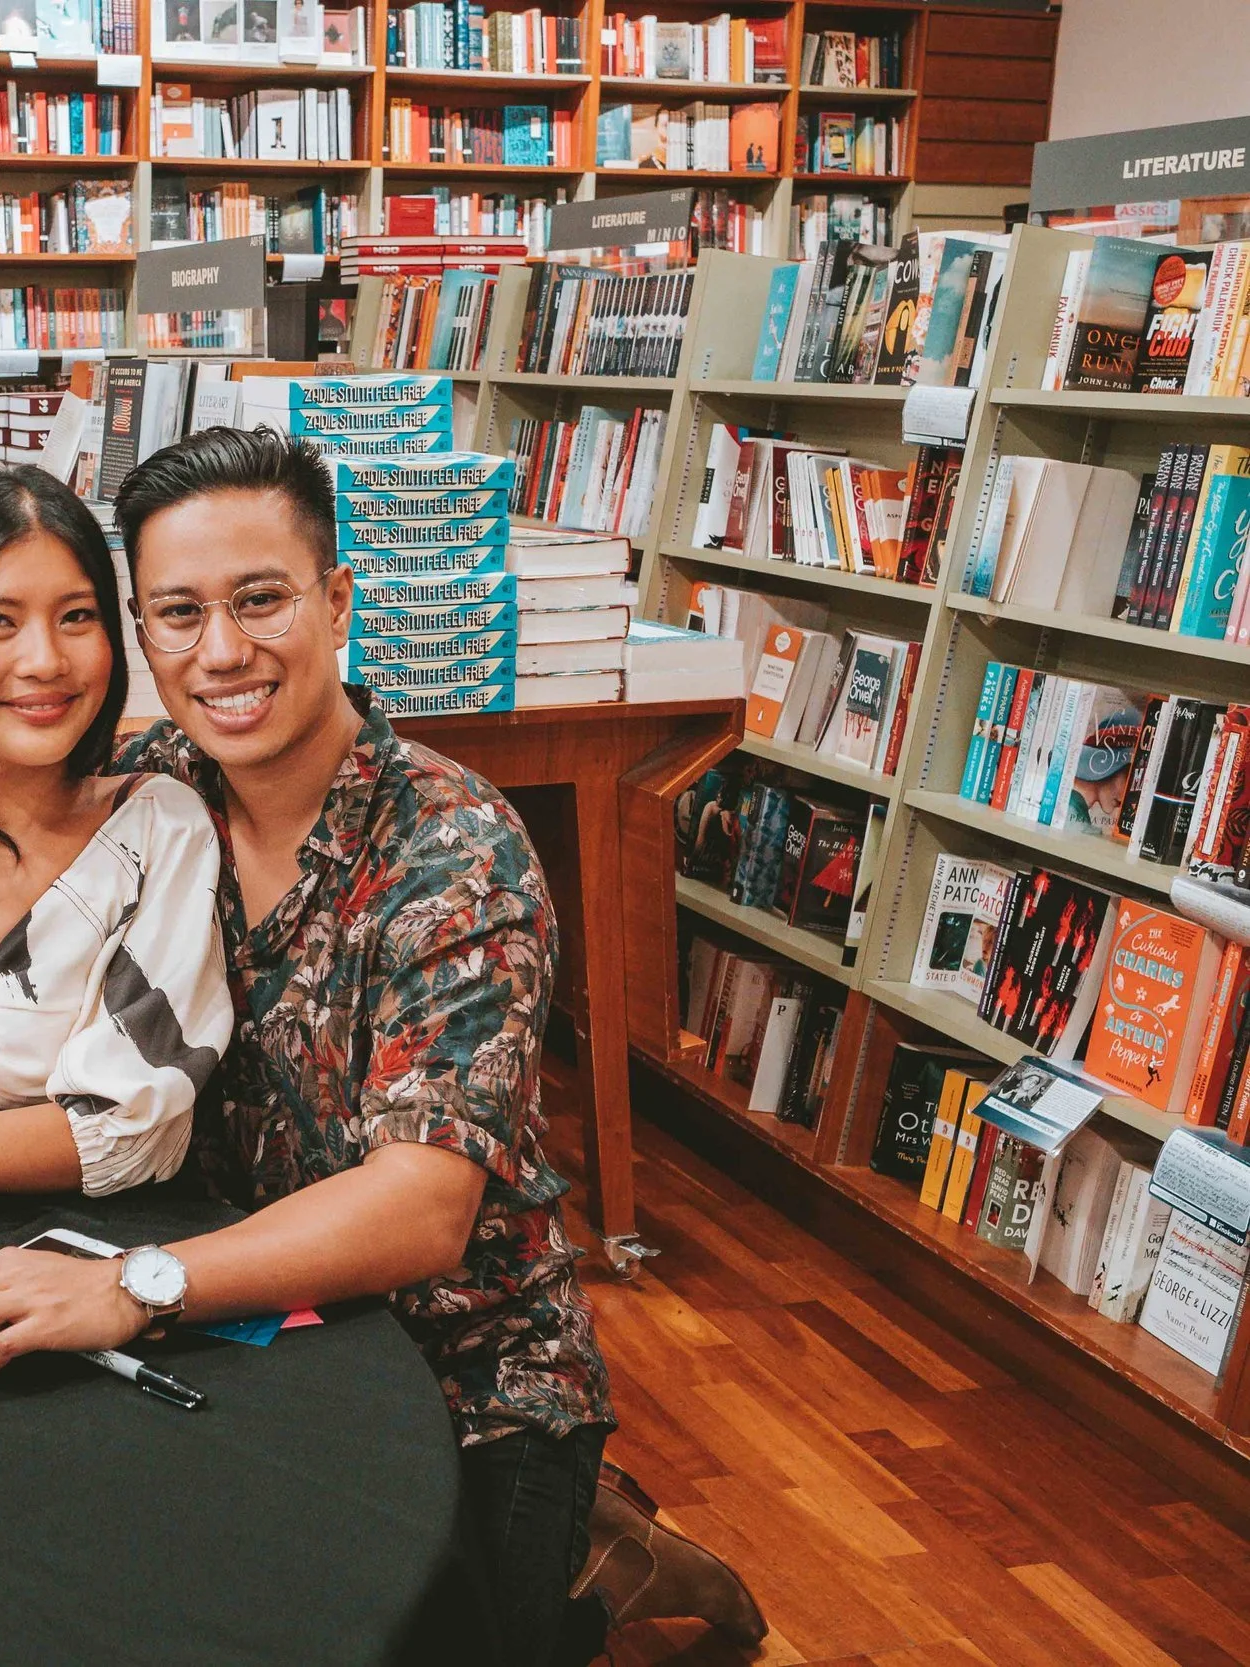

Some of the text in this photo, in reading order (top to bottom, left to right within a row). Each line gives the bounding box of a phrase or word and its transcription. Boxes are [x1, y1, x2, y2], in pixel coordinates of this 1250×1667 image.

[1123, 148, 1246, 179] LITERATURE
[592, 211, 646, 228] LITERATURE
[172, 267, 220, 287] BIOGRAPHY
[1212, 247, 1238, 332] CHUCK PALAHNIUK
[1048, 296, 1069, 358] PALAHNIUK
[1148, 331, 1190, 357] Club
[1078, 375, 1113, 388] JOHN L.
[1150, 376, 1178, 390] Chuck
[1176, 453, 1188, 489] ORHAN
[1192, 455, 1204, 491] ORHAN
[352, 498, 481, 516] ZADIE SMITH FEEL FREE
[1152, 562, 1162, 586] Woman
[1167, 564, 1177, 588] Woman
[362, 583, 490, 604] ZADIE SMITH FEEL FREE
[363, 639, 491, 661] ZADIE SMITH FEEL FREE
[853, 669, 881, 691] George
[980, 671, 994, 712] PARKS
[997, 674, 1013, 722] Adele PARKS
[948, 866, 979, 884] ANN
[929, 858, 947, 923] ANN PATCHETT
[943, 885, 980, 903] PATC
[1131, 934, 1177, 965] Curious
[925, 971, 947, 982] STATE
[1056, 965, 1067, 990] KENNETH
[1060, 968, 1071, 992] PATCHEN
[1115, 949, 1184, 988] CHARMS
[1130, 1011, 1143, 1023] OF
[1104, 1014, 1166, 1054] ARTHUR
[1109, 1039, 1148, 1068] Pepper
[1222, 1085, 1236, 1116] PATTEN
[895, 1132, 917, 1145] Mrs
[993, 1173, 1009, 1187] DEAD
[995, 1167, 1006, 1176] RED
[989, 1189, 1007, 1203] PEACE
[990, 1182, 1008, 1196] DAVID
[1216, 1220, 1244, 1244] Kinokuniya
[1154, 1272, 1196, 1308] GEORGE
[1165, 1310, 1211, 1346] Nancy Pearl
